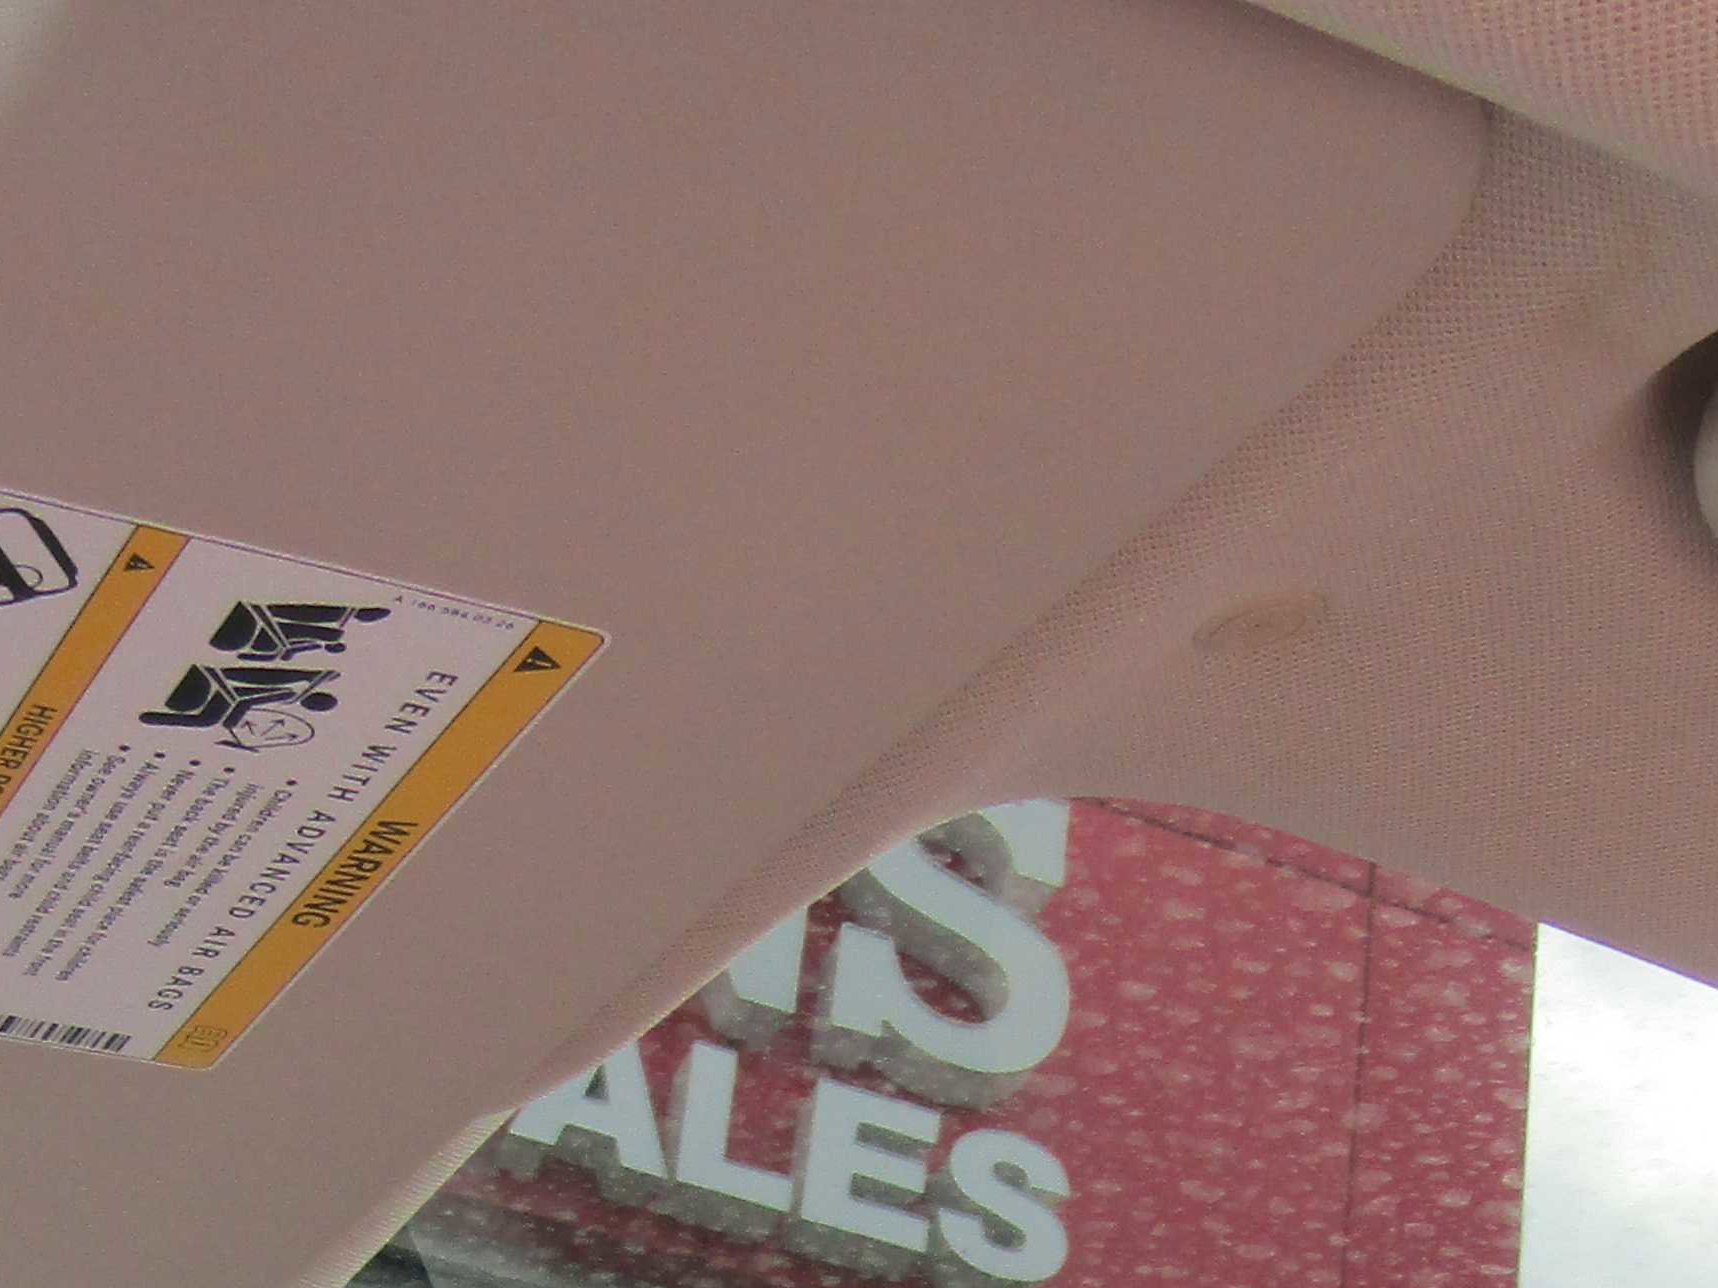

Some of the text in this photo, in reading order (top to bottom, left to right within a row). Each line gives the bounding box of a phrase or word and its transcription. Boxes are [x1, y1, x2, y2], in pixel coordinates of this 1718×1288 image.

[7, 754, 126, 899] See owner's manual for more
[18, 812, 54, 843] about
[41, 749, 100, 811] information
[145, 670, 459, 1011] EVEN WITH ADVANCED AIR BAGS
[161, 782, 264, 888] injured by the air bag
[0, 761, 160, 958] Always use seat belts and child restraints
[7, 842, 32, 858] air
[53, 777, 229, 983] The back seat is the safest place for children
[145, 788, 294, 948] Children can be killed or seriously
[288, 817, 418, 929] WARNING
